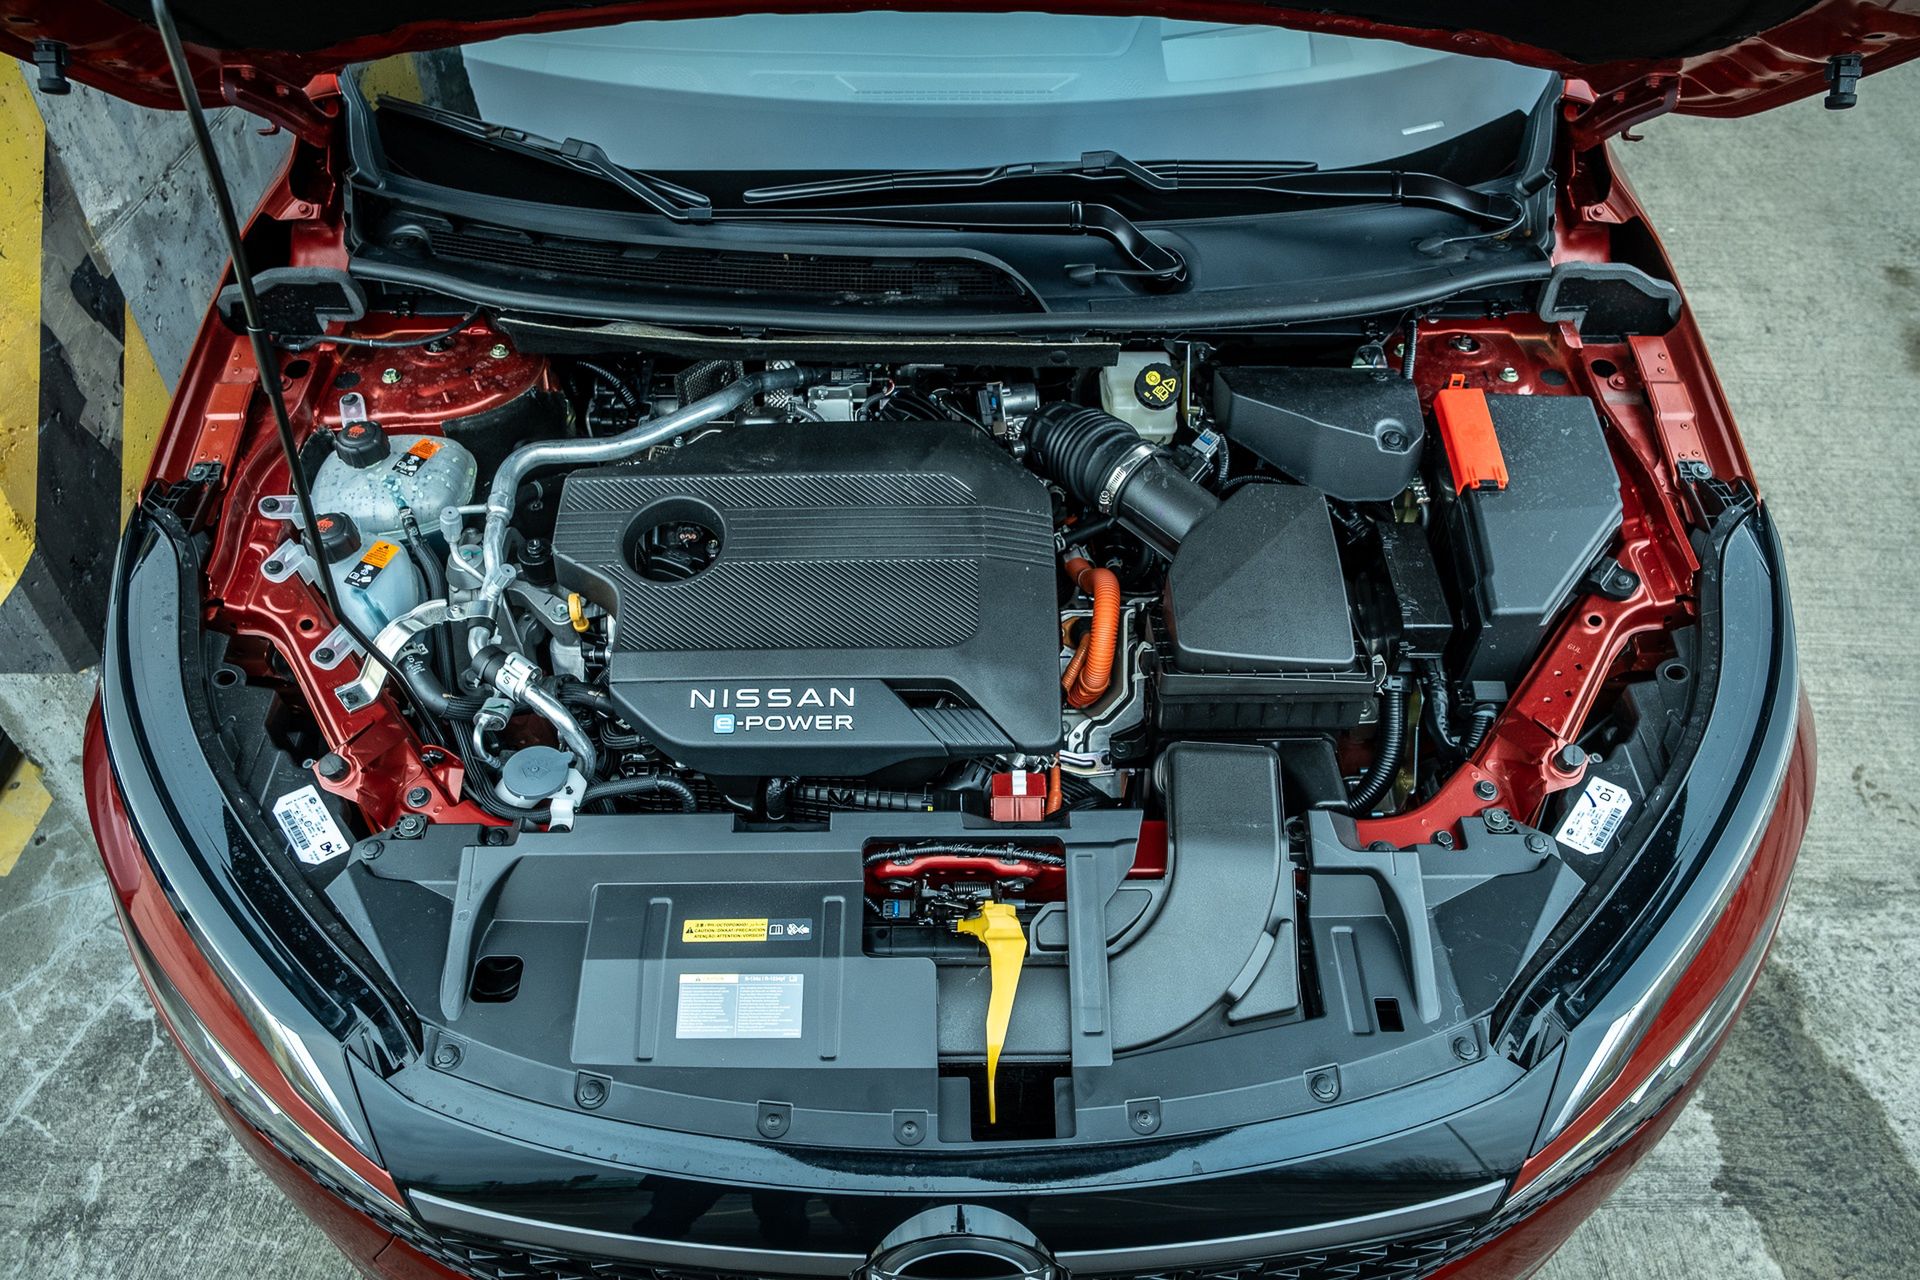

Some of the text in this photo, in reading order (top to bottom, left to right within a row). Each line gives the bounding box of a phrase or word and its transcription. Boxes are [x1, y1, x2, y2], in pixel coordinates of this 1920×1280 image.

[689, 687, 855, 709] NISSAN
[713, 713, 854, 734] e-POWER
[1599, 787, 1615, 802] D1
